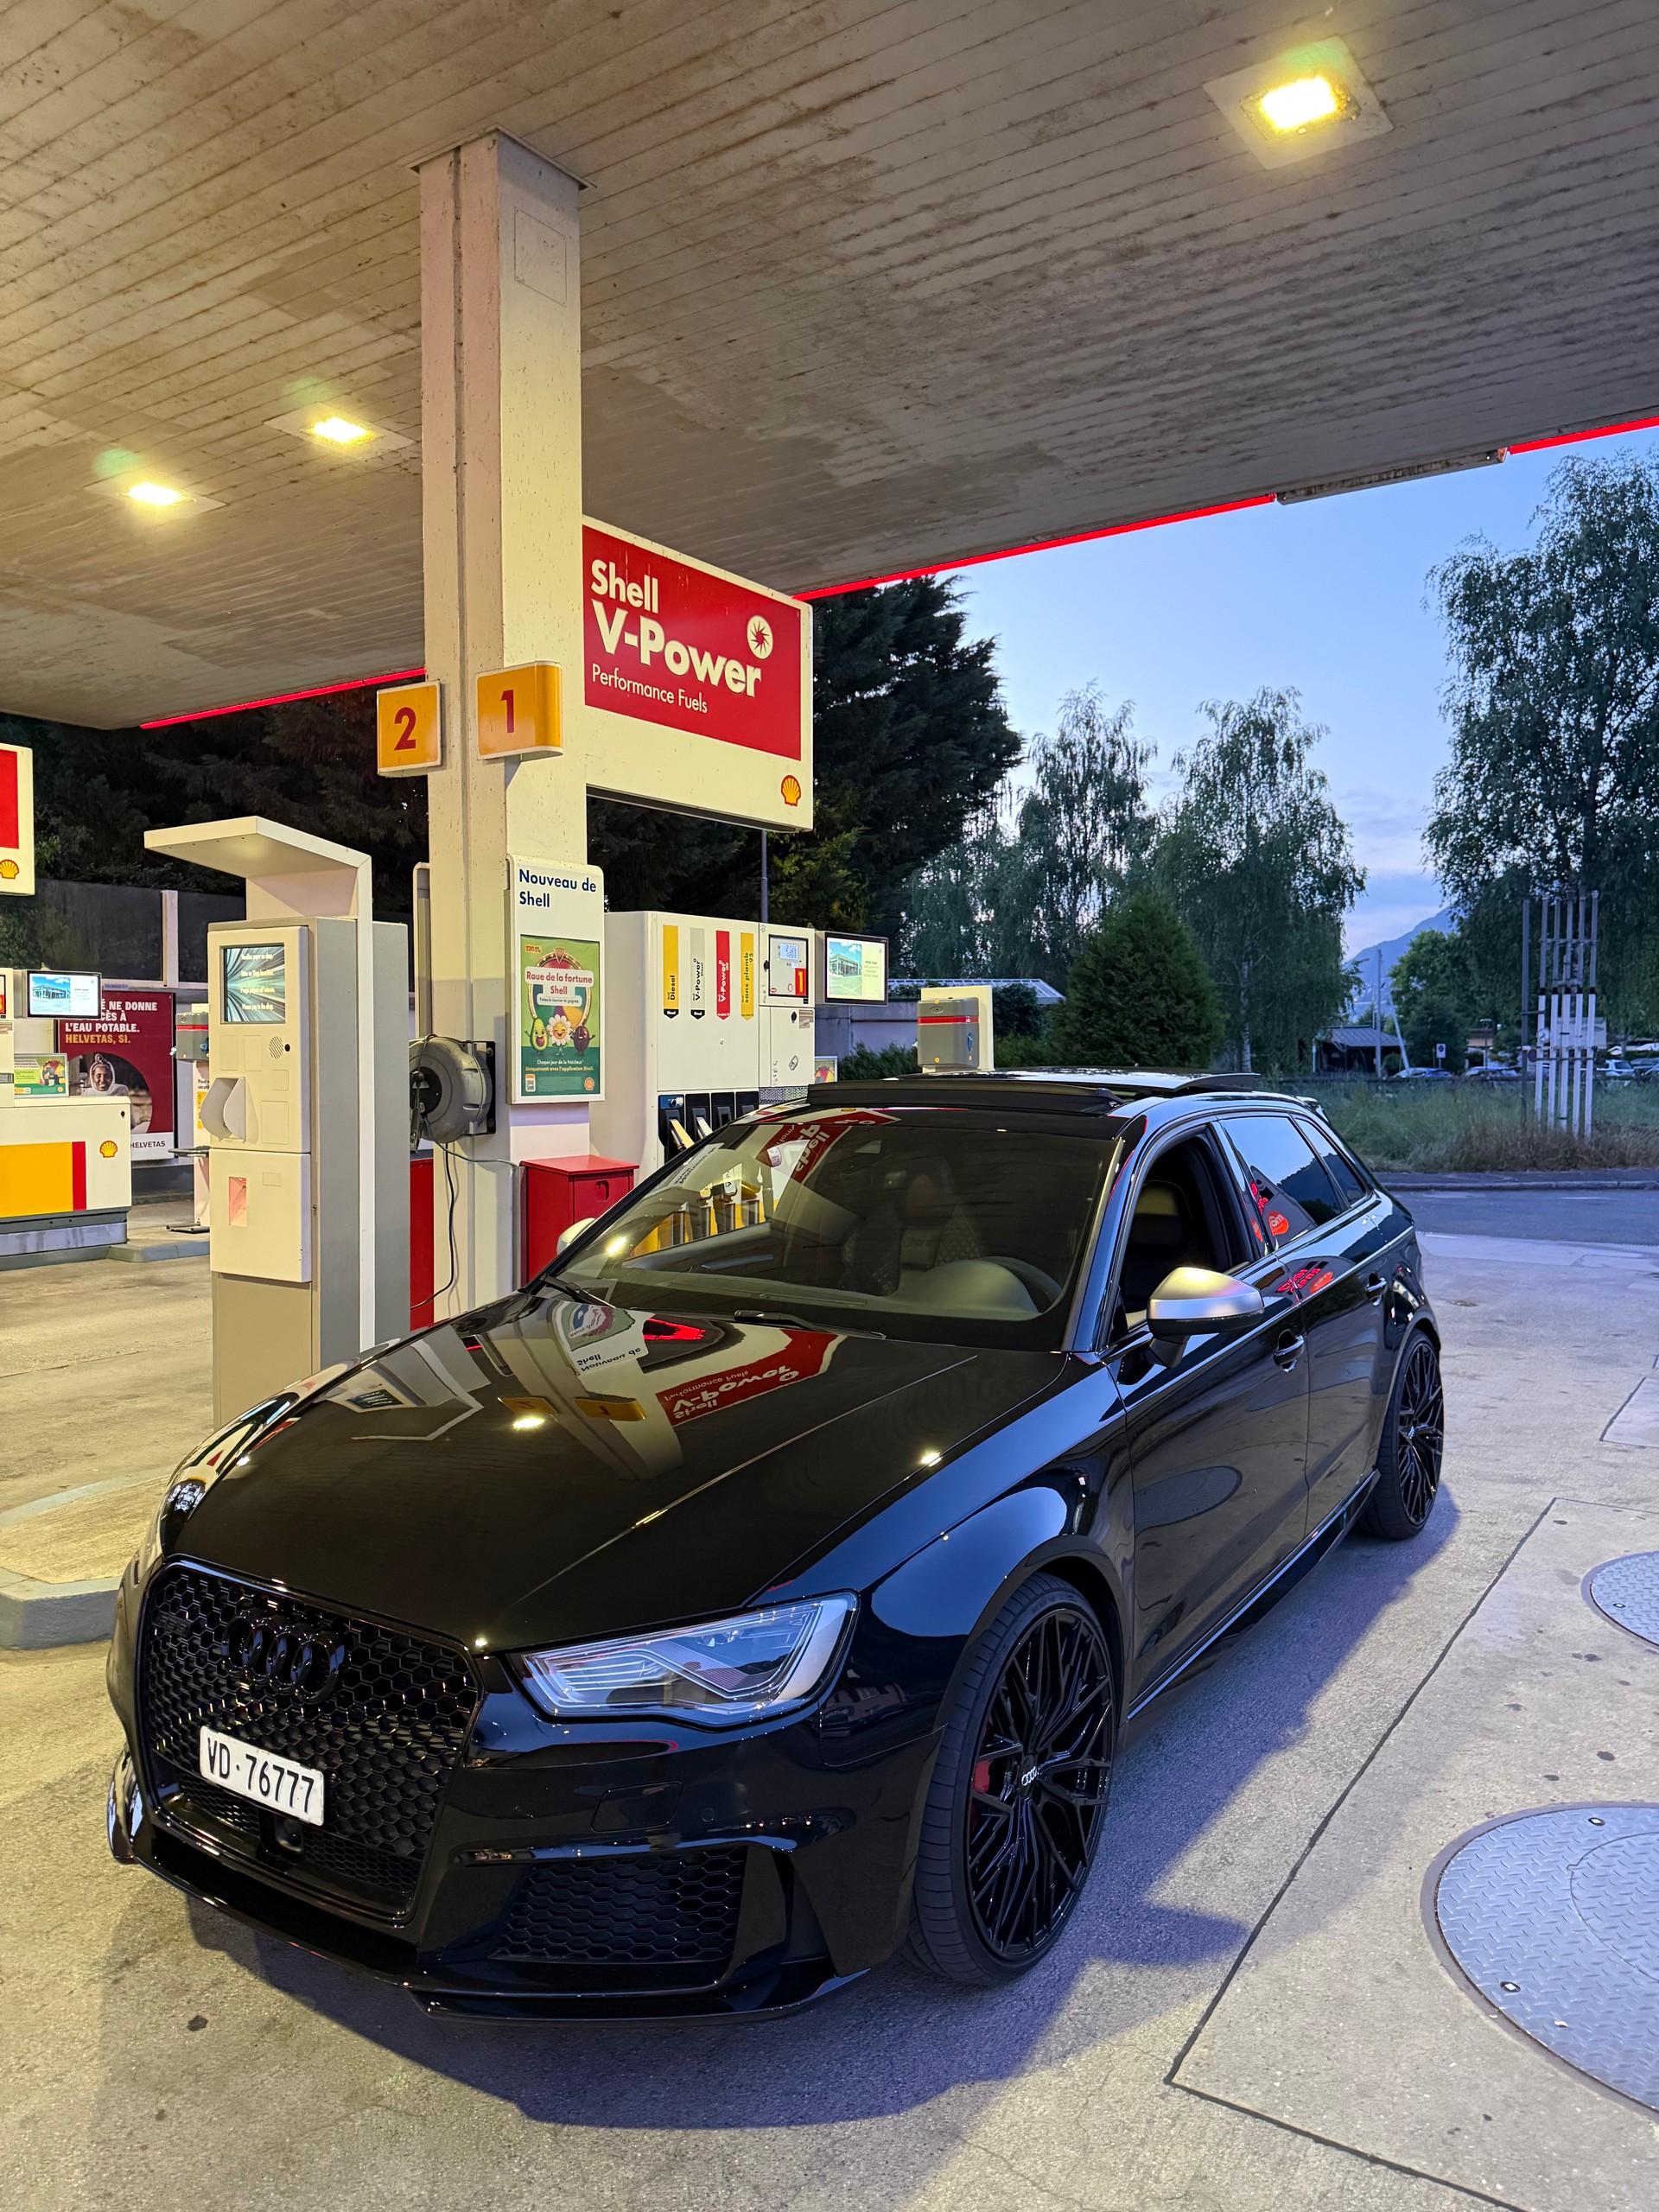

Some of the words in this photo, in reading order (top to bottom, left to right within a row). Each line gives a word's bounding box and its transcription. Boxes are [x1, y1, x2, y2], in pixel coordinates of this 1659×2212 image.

[591, 559, 658, 613] Shell
[591, 599, 761, 697] V-Power
[592, 664, 674, 704] Performance
[678, 690, 708, 714] Fuels
[500, 690, 514, 734] 1
[394, 707, 416, 751] 2
[519, 868, 577, 890] Nouveau
[582, 877, 596, 892] de
[519, 891, 550, 907] Shell
[749, 953, 753, 963] 95
[526, 971, 544, 981] Roue
[546, 972, 555, 982] de
[556, 973, 563, 982] la
[565, 974, 593, 983] fortune
[798, 971, 804, 993] 1
[550, 986, 568, 995] Shell
[109, 1001, 122, 1010] NE
[125, 1001, 157, 1011] DONNE
[120, 1010, 127, 1021] À
[65, 1023, 92, 1033] L'EAU
[96, 1023, 140, 1033] POTABLE.
[65, 1034, 116, 1045] HELVETAS,
[118, 1034, 130, 1044] SI.
[207, 1737, 230, 1779] VD
[245, 1753, 315, 1814] 76777
